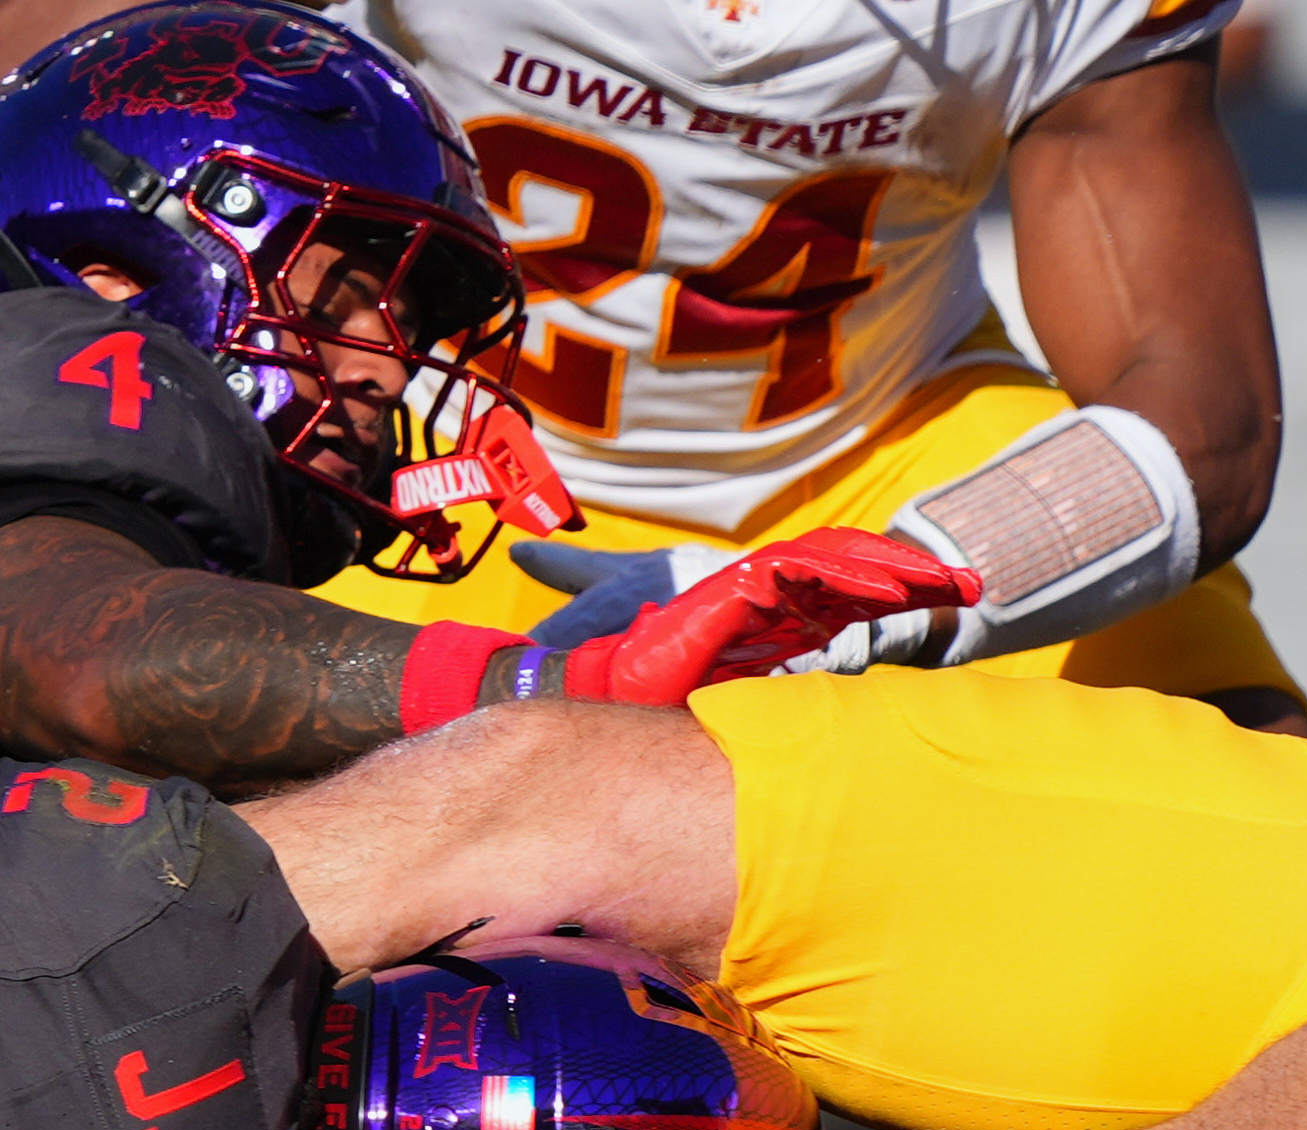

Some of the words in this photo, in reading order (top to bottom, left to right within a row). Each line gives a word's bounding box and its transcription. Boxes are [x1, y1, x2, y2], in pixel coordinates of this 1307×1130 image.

[492, 46, 667, 128] IOWA
[685, 104, 911, 157] STATE
[443, 114, 886, 440] 24
[58, 330, 154, 432] 4
[395, 458, 493, 512] NXTRND
[317, 1004, 358, 1089] GIVE
